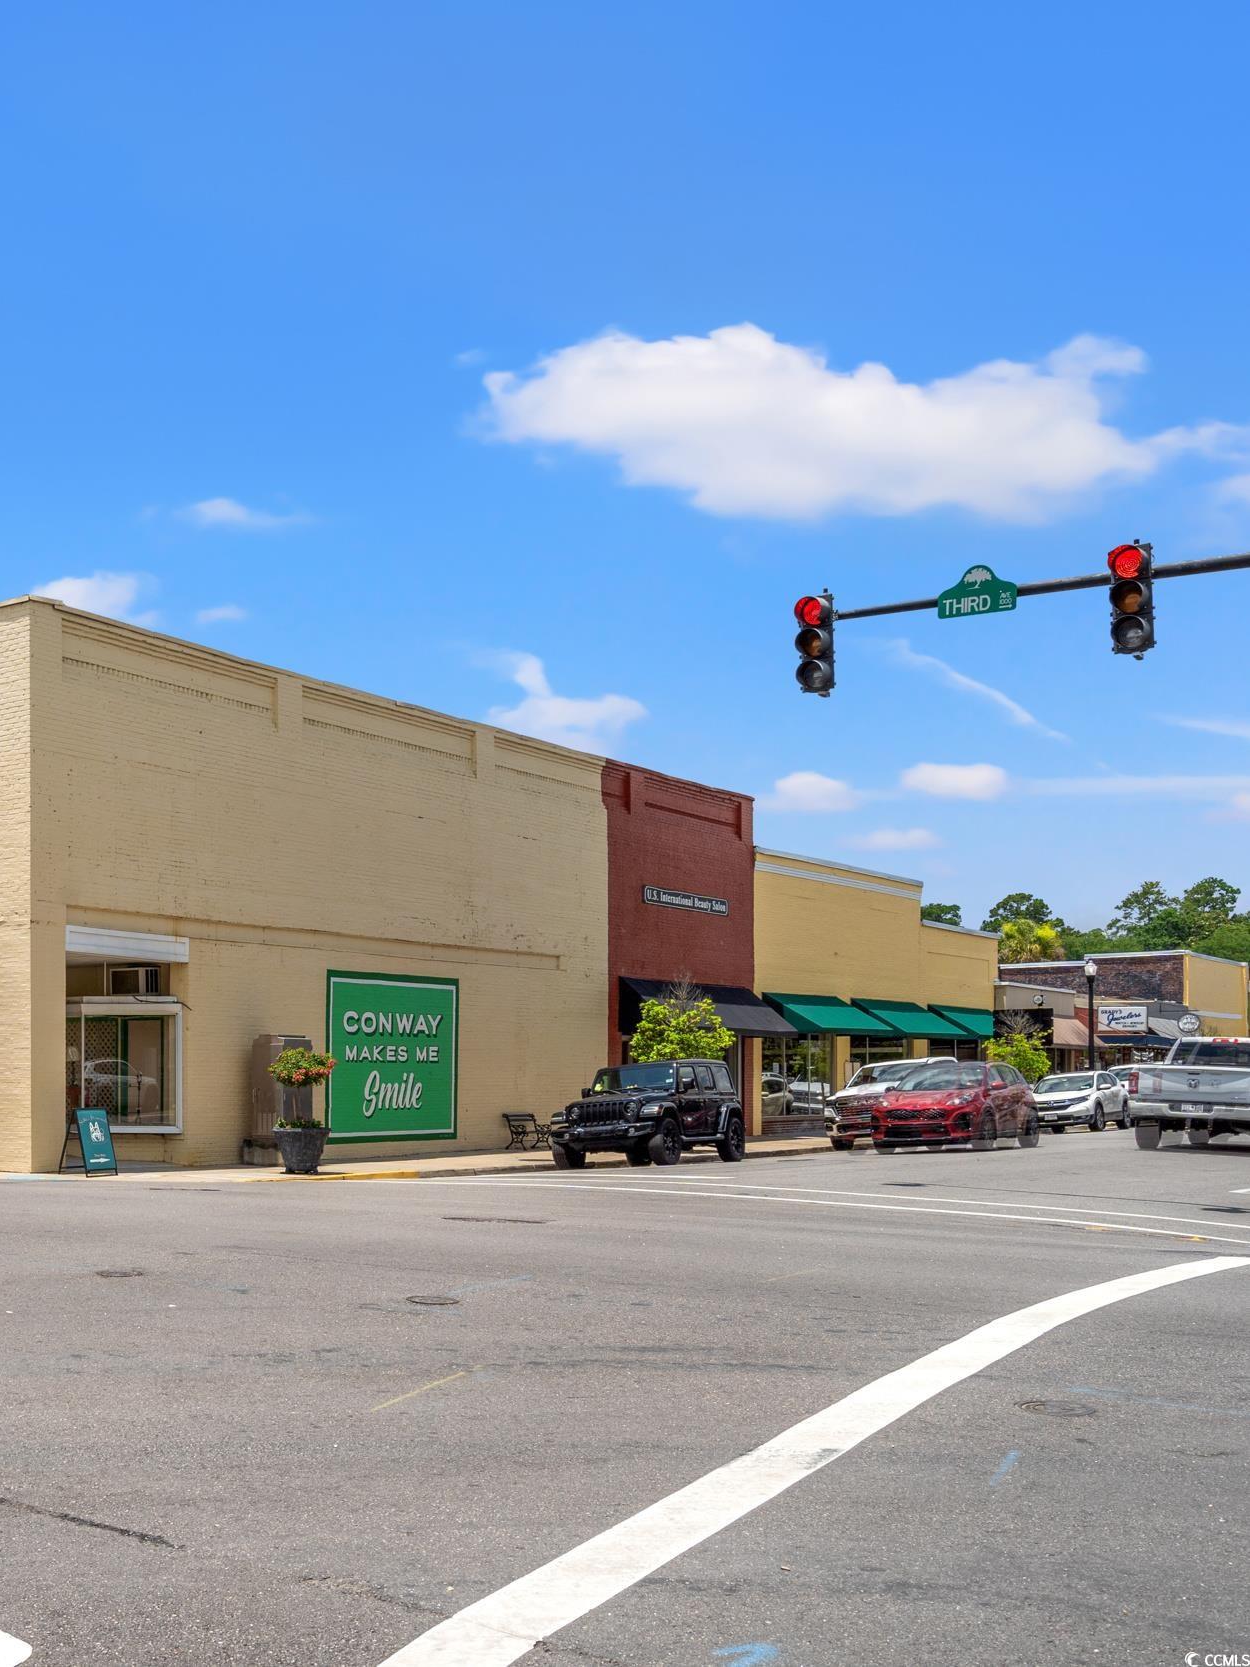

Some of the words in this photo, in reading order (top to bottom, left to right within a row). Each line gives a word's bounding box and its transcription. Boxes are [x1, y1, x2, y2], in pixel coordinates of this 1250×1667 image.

[943, 594, 991, 616] THIRD
[646, 889, 659, 901] U.S.
[660, 892, 694, 907] International
[694, 897, 711, 912] Beauty
[712, 901, 726, 912] Salon
[343, 1010, 443, 1038] CONWAY
[1106, 1011, 1142, 1026] Jewelers
[345, 1045, 408, 1063] MAKES
[416, 1046, 440, 1063] ME
[362, 1070, 424, 1119] Smile
